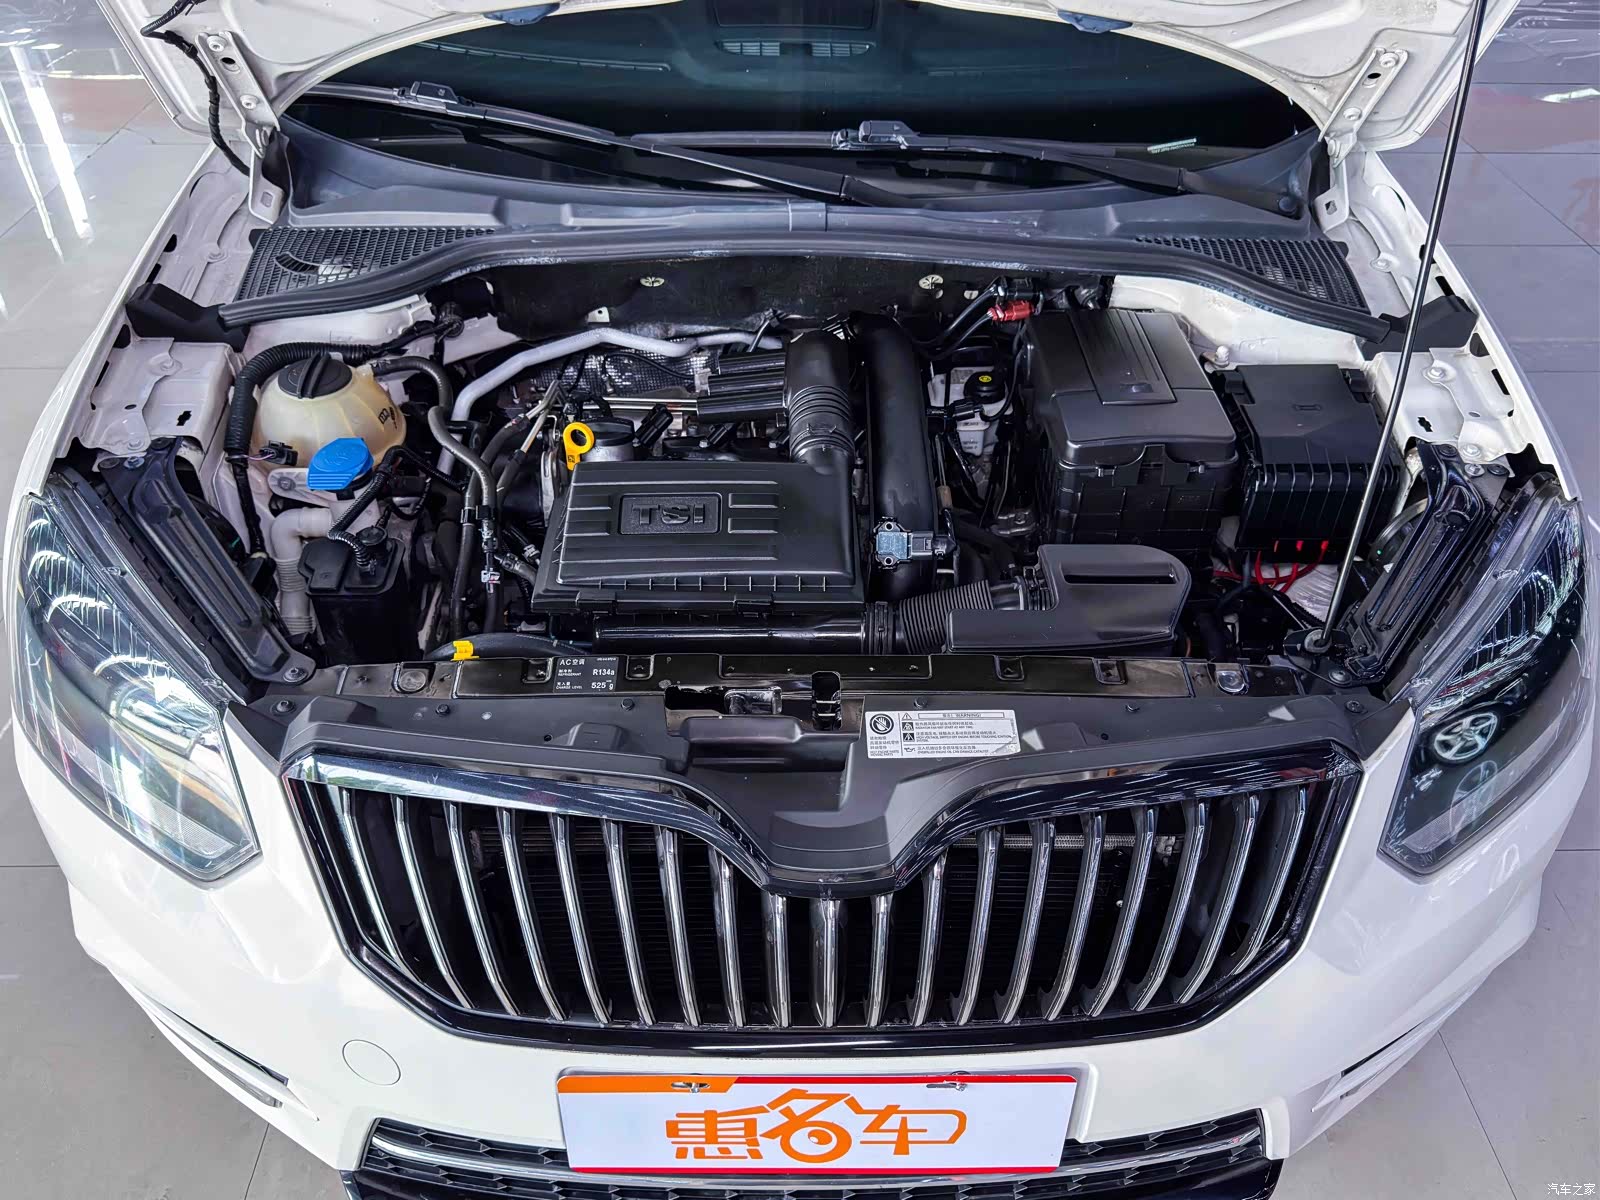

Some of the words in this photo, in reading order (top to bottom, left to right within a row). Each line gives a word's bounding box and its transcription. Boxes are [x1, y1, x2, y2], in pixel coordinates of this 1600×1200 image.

[632, 503, 705, 525] TSI
[592, 668, 615, 676] R134a
[591, 681, 606, 689] 525
